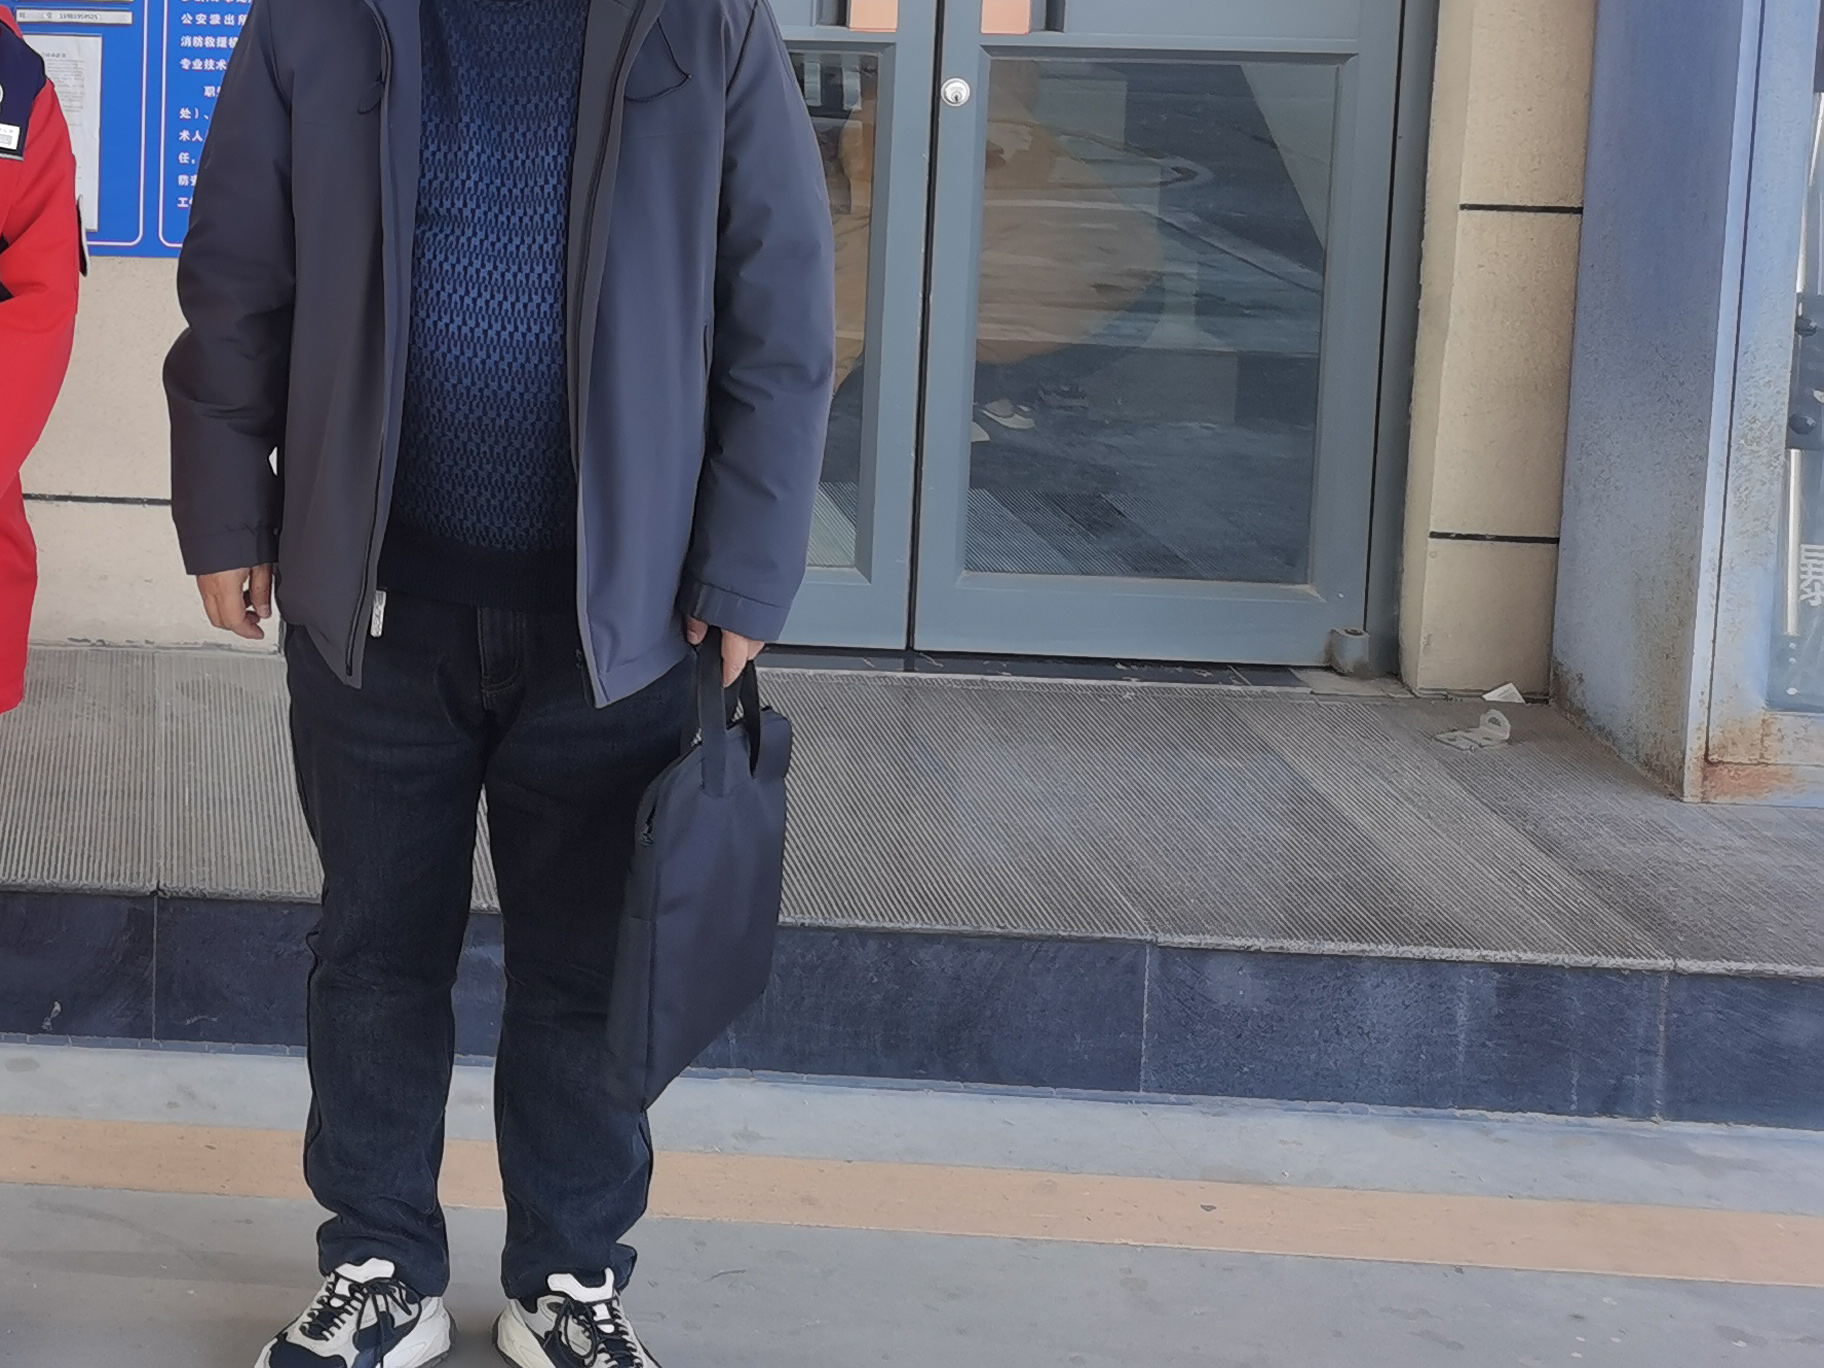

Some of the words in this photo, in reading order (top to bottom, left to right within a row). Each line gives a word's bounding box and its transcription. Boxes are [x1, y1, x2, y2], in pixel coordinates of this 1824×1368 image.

[180, 58, 227, 70] 专业技术
[204, 86, 222, 98] 职
[179, 130, 204, 142] 术人
